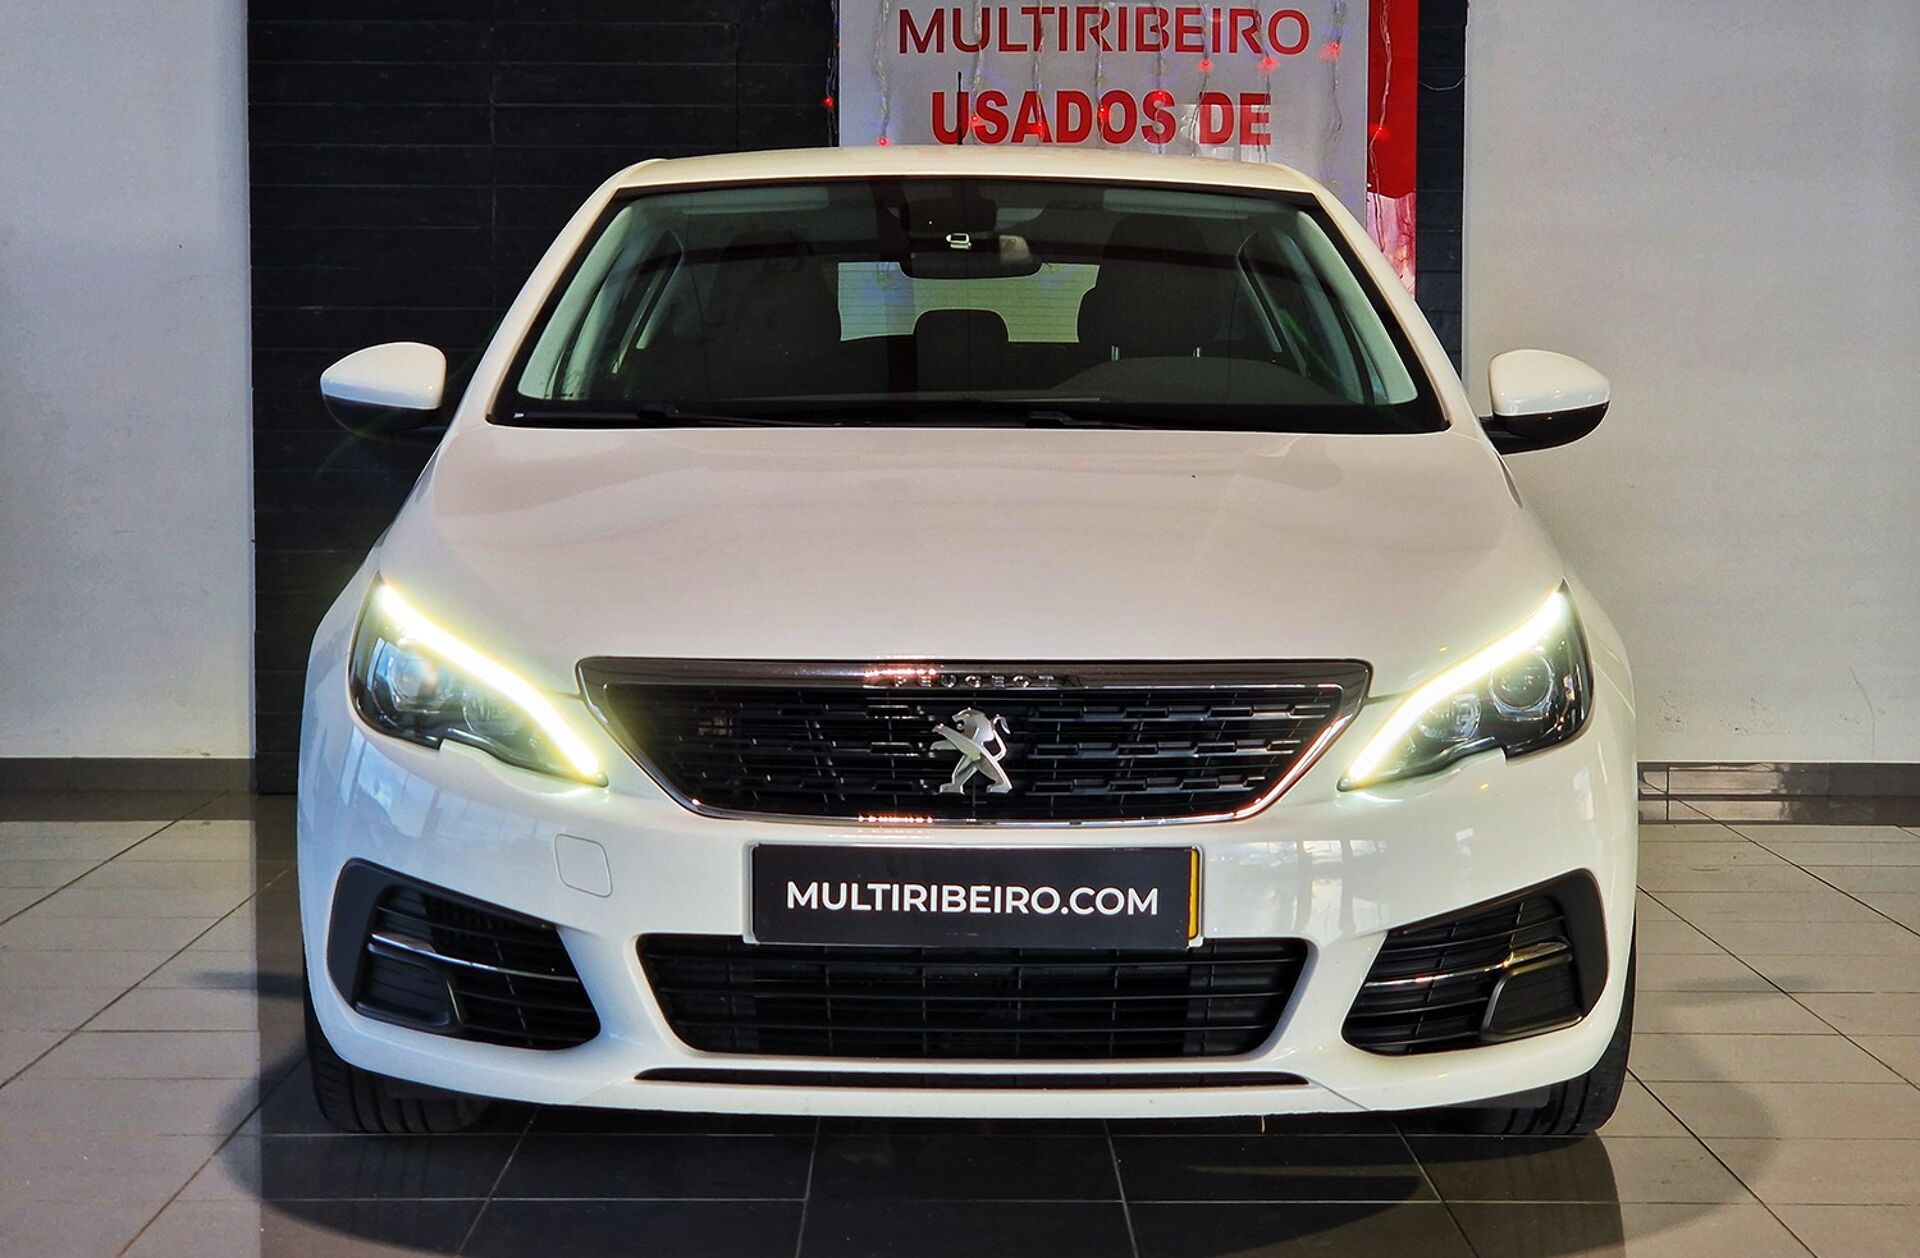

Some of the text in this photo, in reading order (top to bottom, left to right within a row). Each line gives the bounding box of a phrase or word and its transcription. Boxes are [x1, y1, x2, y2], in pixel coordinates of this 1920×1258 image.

[900, 6, 1311, 55] MULTIRIBEIRO
[931, 89, 1271, 145] USADOS DE
[894, 674, 1055, 688] PEUGEOT
[787, 881, 1159, 915] MULTIRIBEIRO.COM
